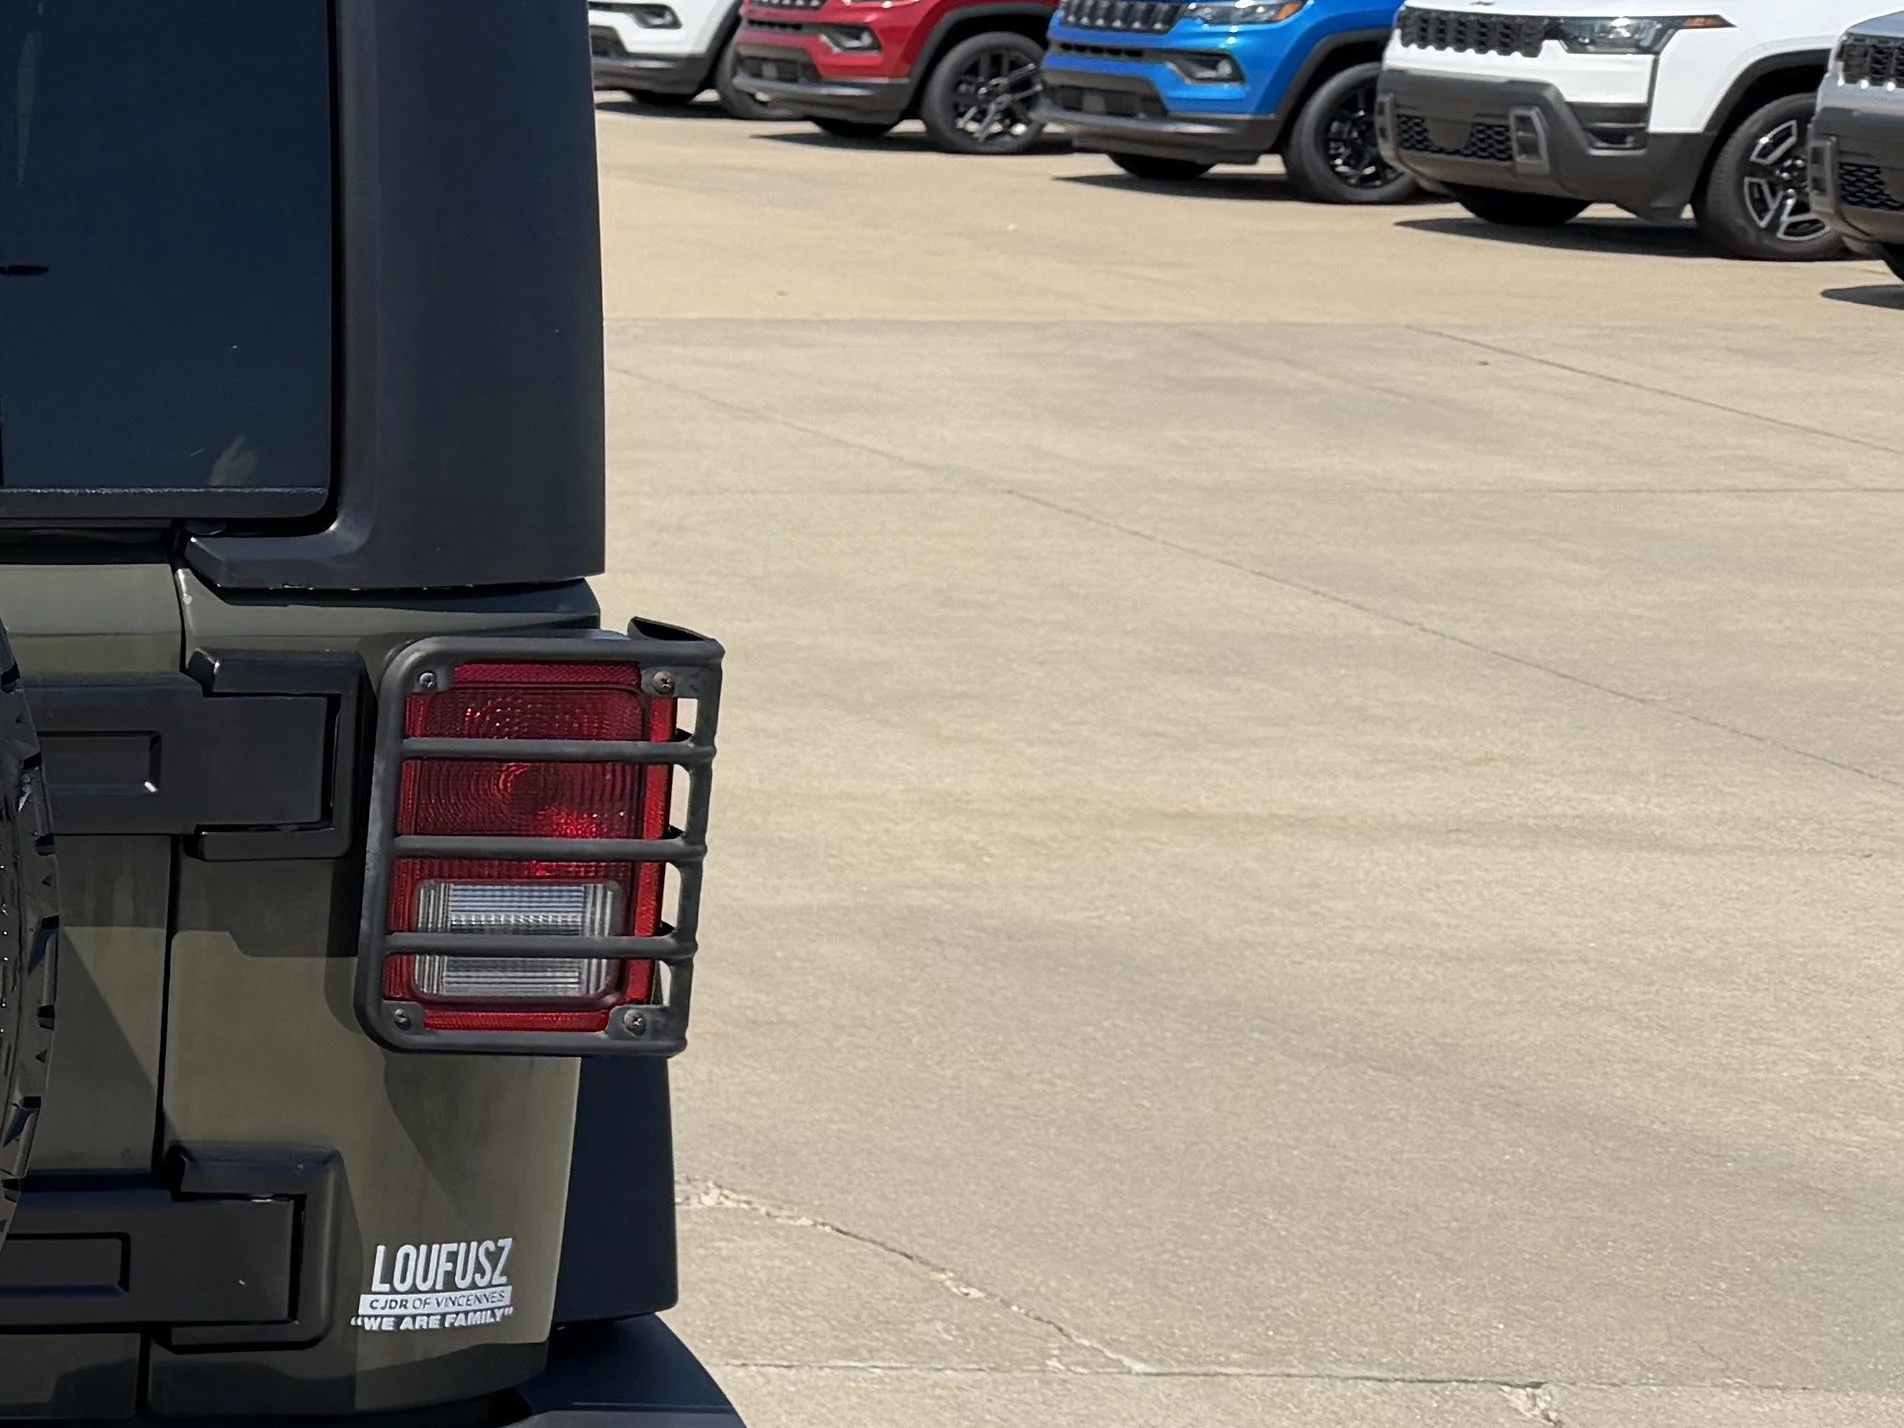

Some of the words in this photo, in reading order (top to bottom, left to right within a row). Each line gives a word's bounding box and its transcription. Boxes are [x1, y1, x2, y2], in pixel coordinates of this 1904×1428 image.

[369, 1298, 409, 1311] CJDR
[412, 1297, 431, 1310] OF
[435, 1290, 505, 1309] VINCENNES
[399, 1314, 442, 1331] ARE
